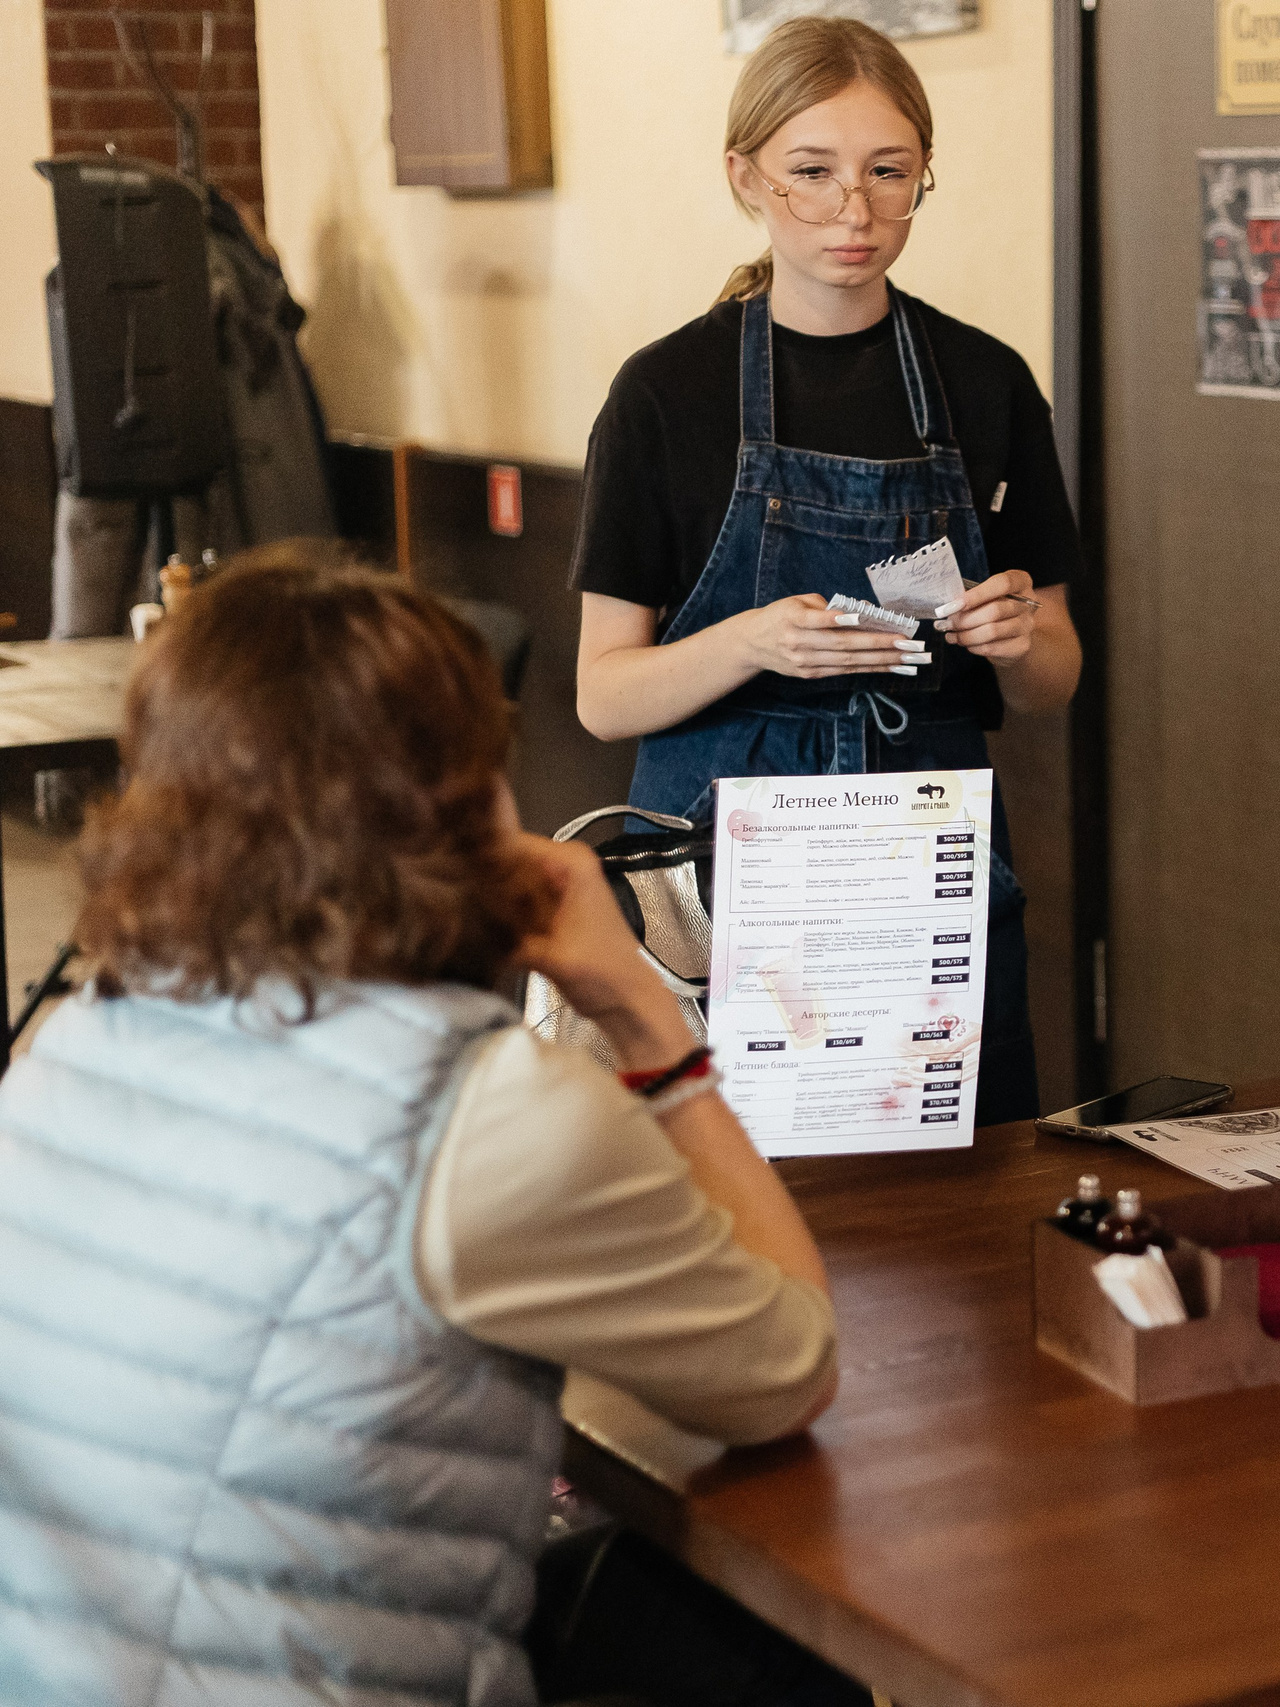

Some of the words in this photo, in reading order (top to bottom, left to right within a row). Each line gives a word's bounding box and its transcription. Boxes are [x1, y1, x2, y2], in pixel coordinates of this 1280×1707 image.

[772, 793, 837, 809] Летнее
[842, 792, 899, 807] Меню
[742, 823, 816, 833] Безалкогольные
[818, 823, 860, 832] напитки:
[738, 919, 800, 927] Алкогольные
[802, 918, 844, 926] напитки:
[801, 1010, 850, 1020] Авторские
[852, 1008, 892, 1017] десерты:
[734, 1062, 768, 1070] Летние
[770, 1061, 801, 1069] блюда:
